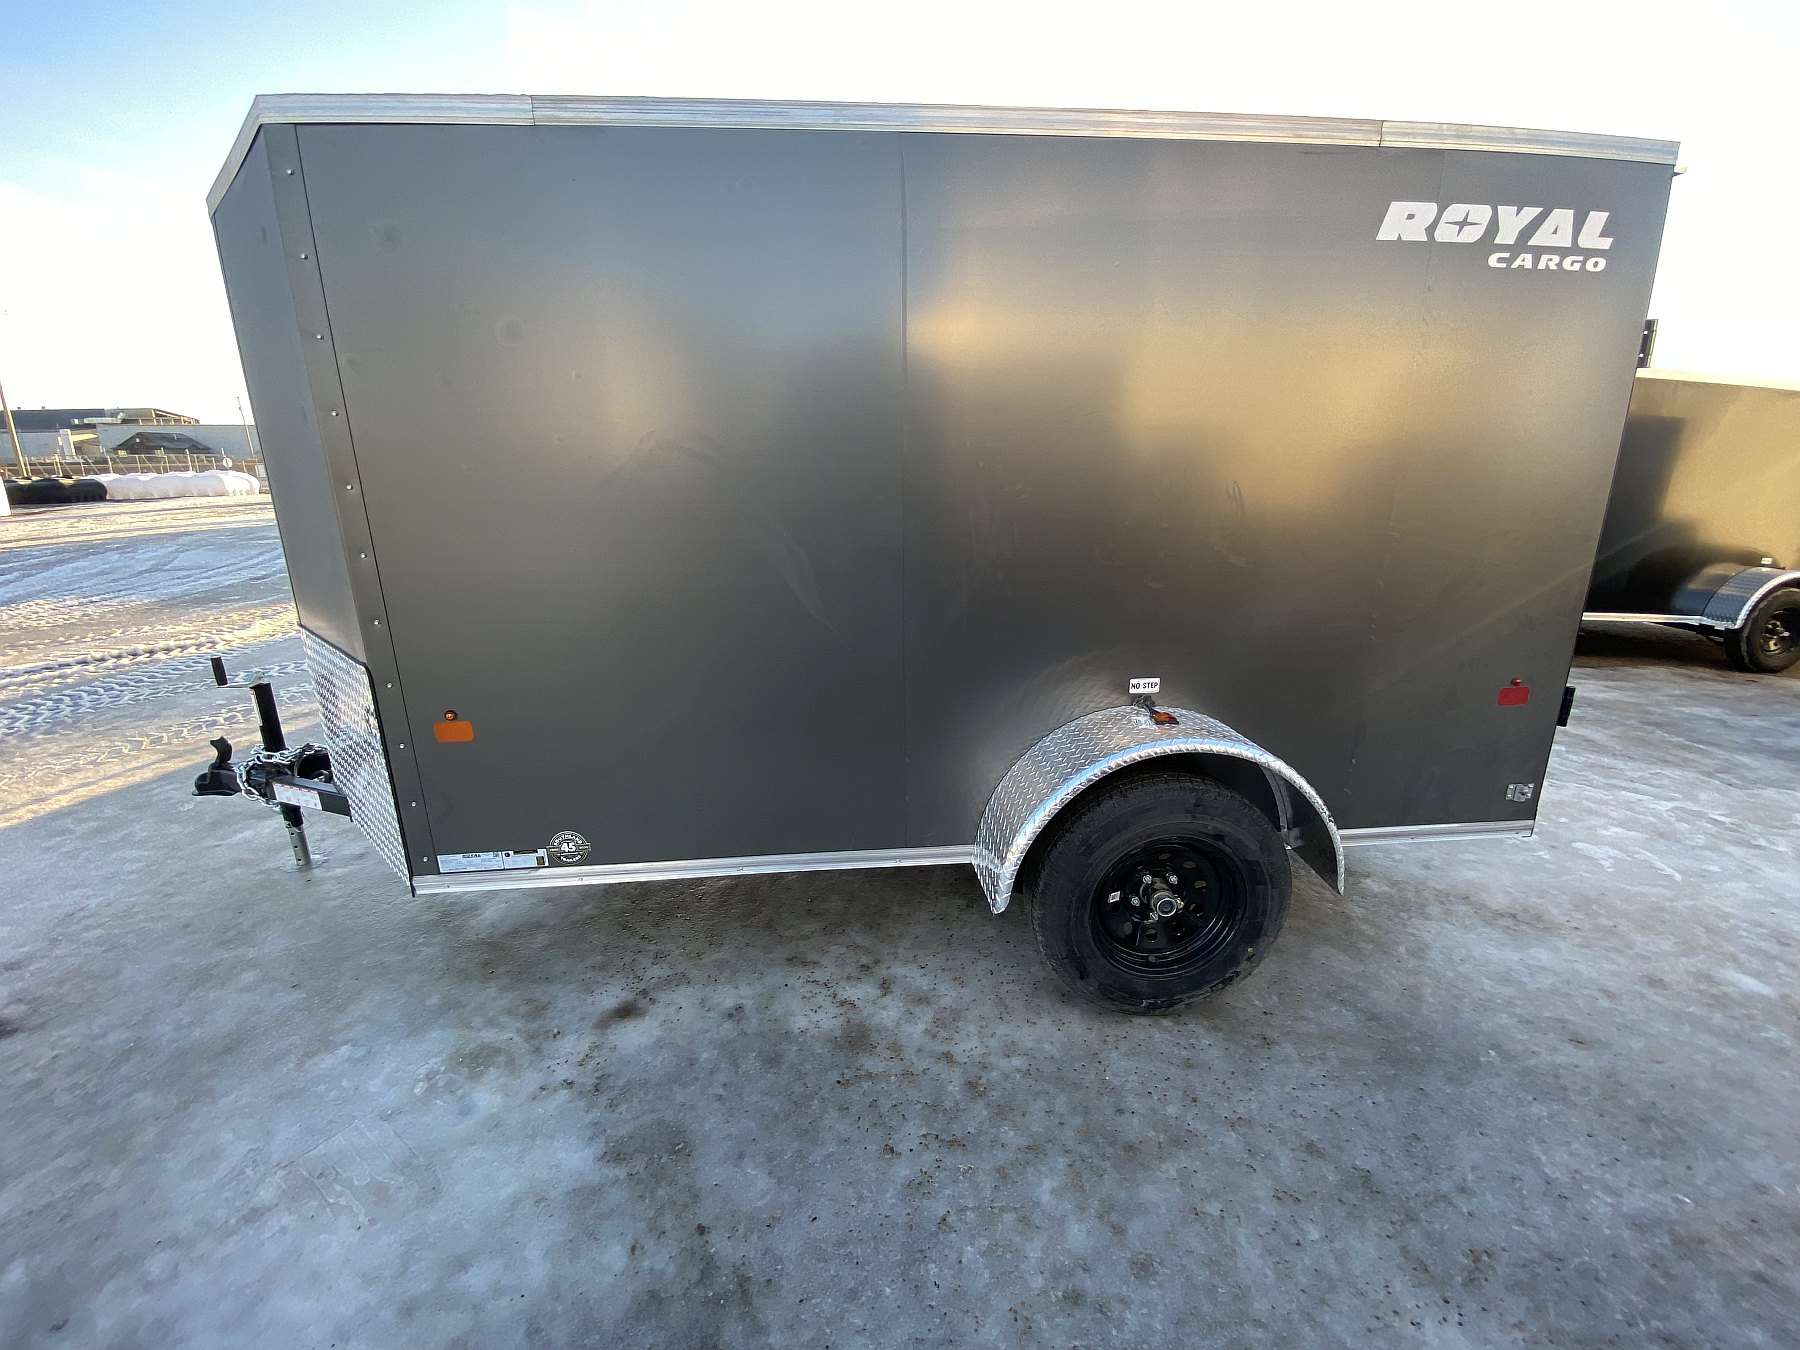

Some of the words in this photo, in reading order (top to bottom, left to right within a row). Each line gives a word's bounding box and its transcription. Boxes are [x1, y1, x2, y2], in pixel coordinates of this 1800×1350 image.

[1376, 201, 1614, 250] ROYAL
[1487, 252, 1607, 272] CARGO
[1130, 682, 1141, 690] NO
[1142, 681, 1159, 689] STEP
[560, 842, 576, 852] 45
